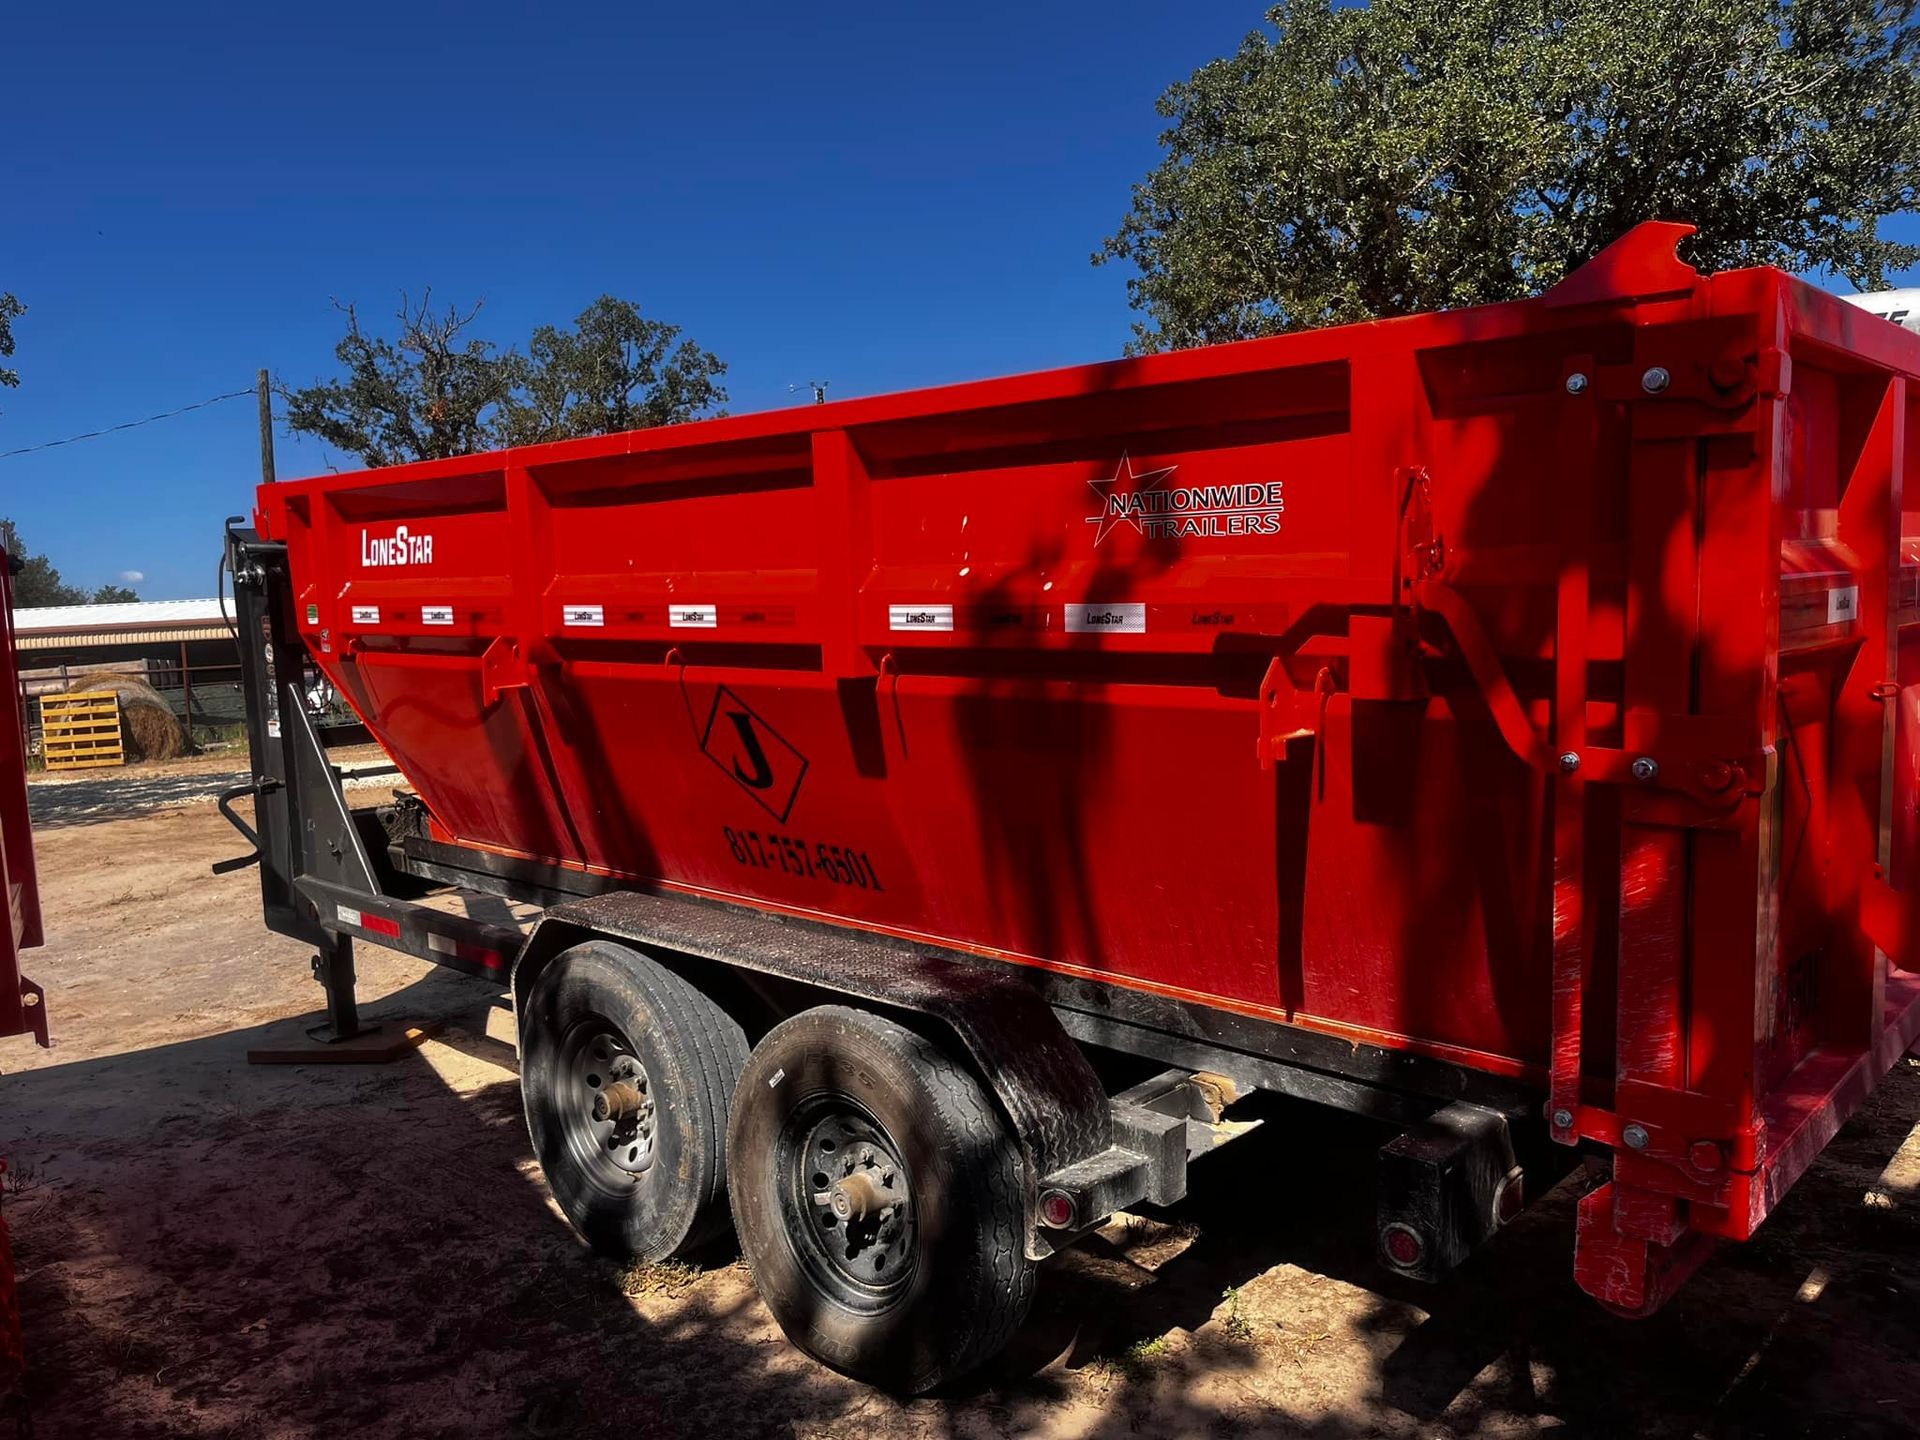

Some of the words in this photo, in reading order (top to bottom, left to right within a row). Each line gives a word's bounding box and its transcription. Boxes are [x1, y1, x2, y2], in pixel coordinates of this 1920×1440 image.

[1109, 481, 1284, 516] NATIONWIDE
[1143, 514, 1281, 540] TRAILERS
[725, 711, 774, 789] J
[723, 825, 884, 892] 817-757-6501
